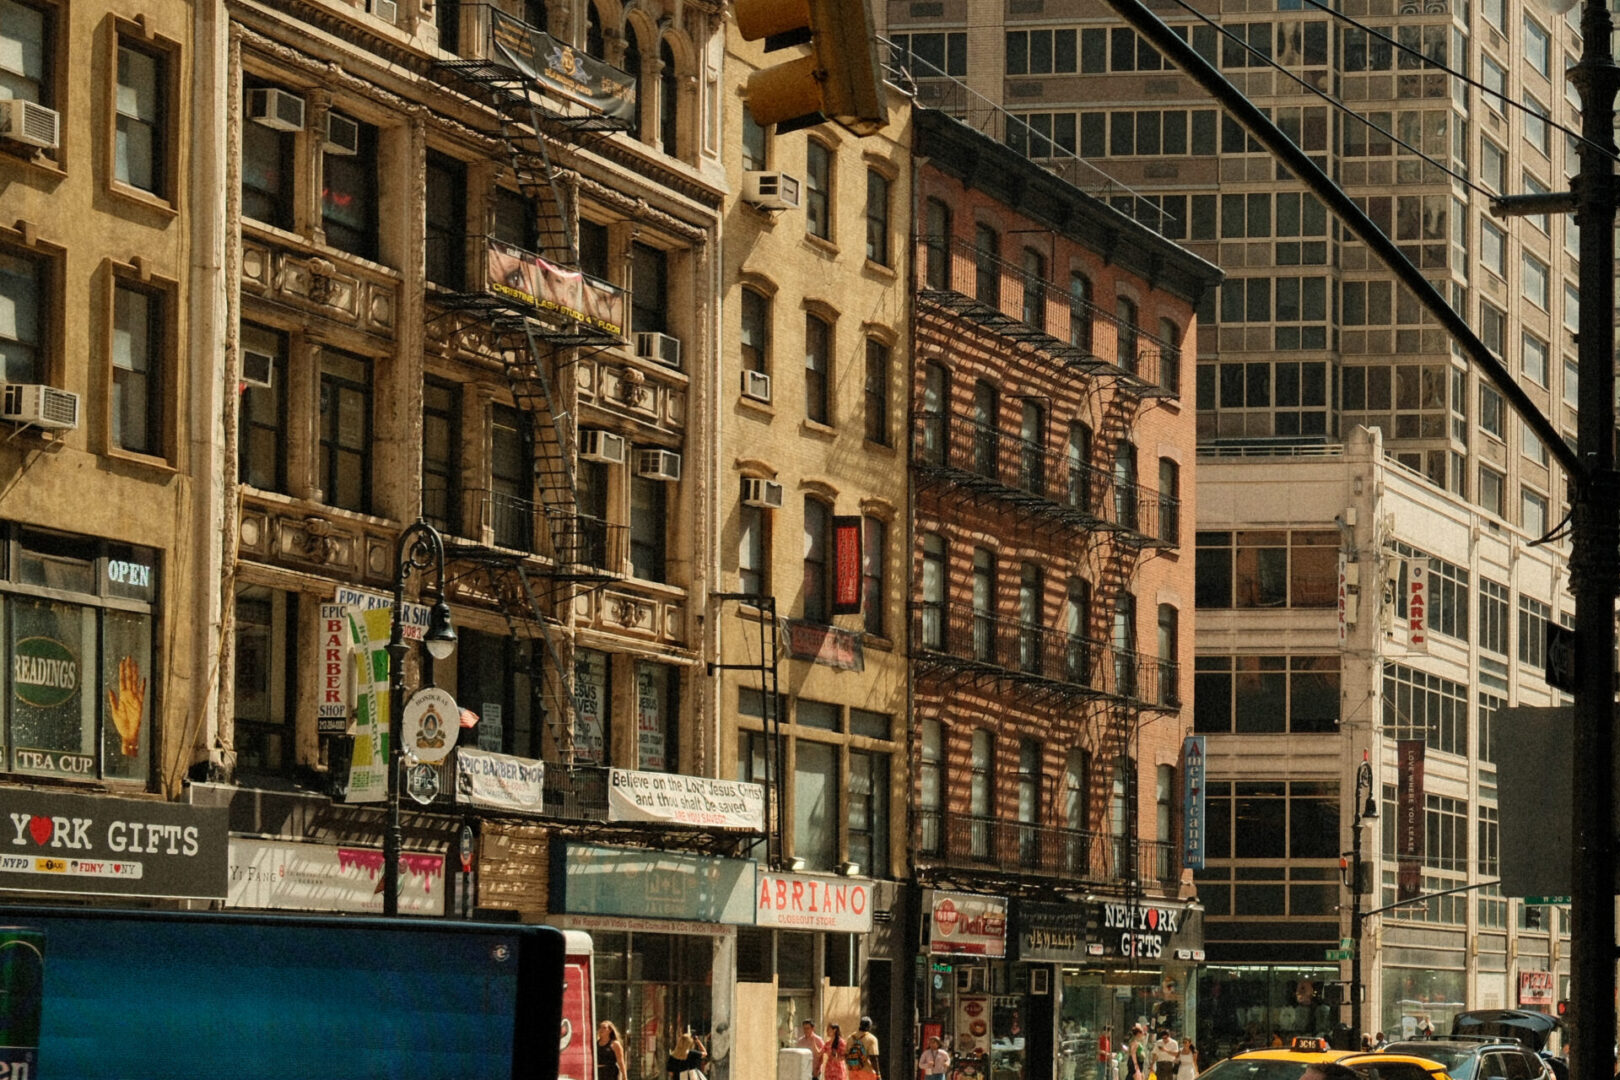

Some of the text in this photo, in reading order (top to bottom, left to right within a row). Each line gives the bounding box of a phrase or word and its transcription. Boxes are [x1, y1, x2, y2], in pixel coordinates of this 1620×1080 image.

[493, 283, 535, 304] CHRISTINE
[536, 298, 559, 311] LASH
[598, 320, 621, 335] FLOOR
[108, 559, 150, 587] OPEN
[1338, 574, 1346, 624] PARK
[1410, 582, 1425, 631] PARK
[322, 607, 347, 618] EPIC
[14, 653, 76, 690] READINGS
[325, 620, 342, 703] BARBER
[415, 694, 448, 707] HONDURAS
[574, 683, 597, 699] ESUS
[319, 705, 346, 716] SHOP
[18, 750, 93, 774] TEA CUP
[459, 755, 481, 774] EPIC
[483, 759, 517, 780] BARBER
[519, 766, 544, 784] SHOP
[612, 771, 764, 800] Believe on the Lord Jesus Christ
[635, 793, 747, 813] and thou shalt be saved
[108, 821, 199, 857] GIFTS
[2, 857, 29, 869] NYPD
[79, 862, 104, 873] FDNY
[759, 877, 866, 915] ABRIANO
[611, 919, 627, 929] Video
[628, 920, 644, 930] Game
[778, 914, 837, 926] CLOSEOUT STORE
[1105, 904, 1136, 929] NEW
[1030, 928, 1077, 947] JEWELRY
[1121, 932, 1162, 958] GIFTS
